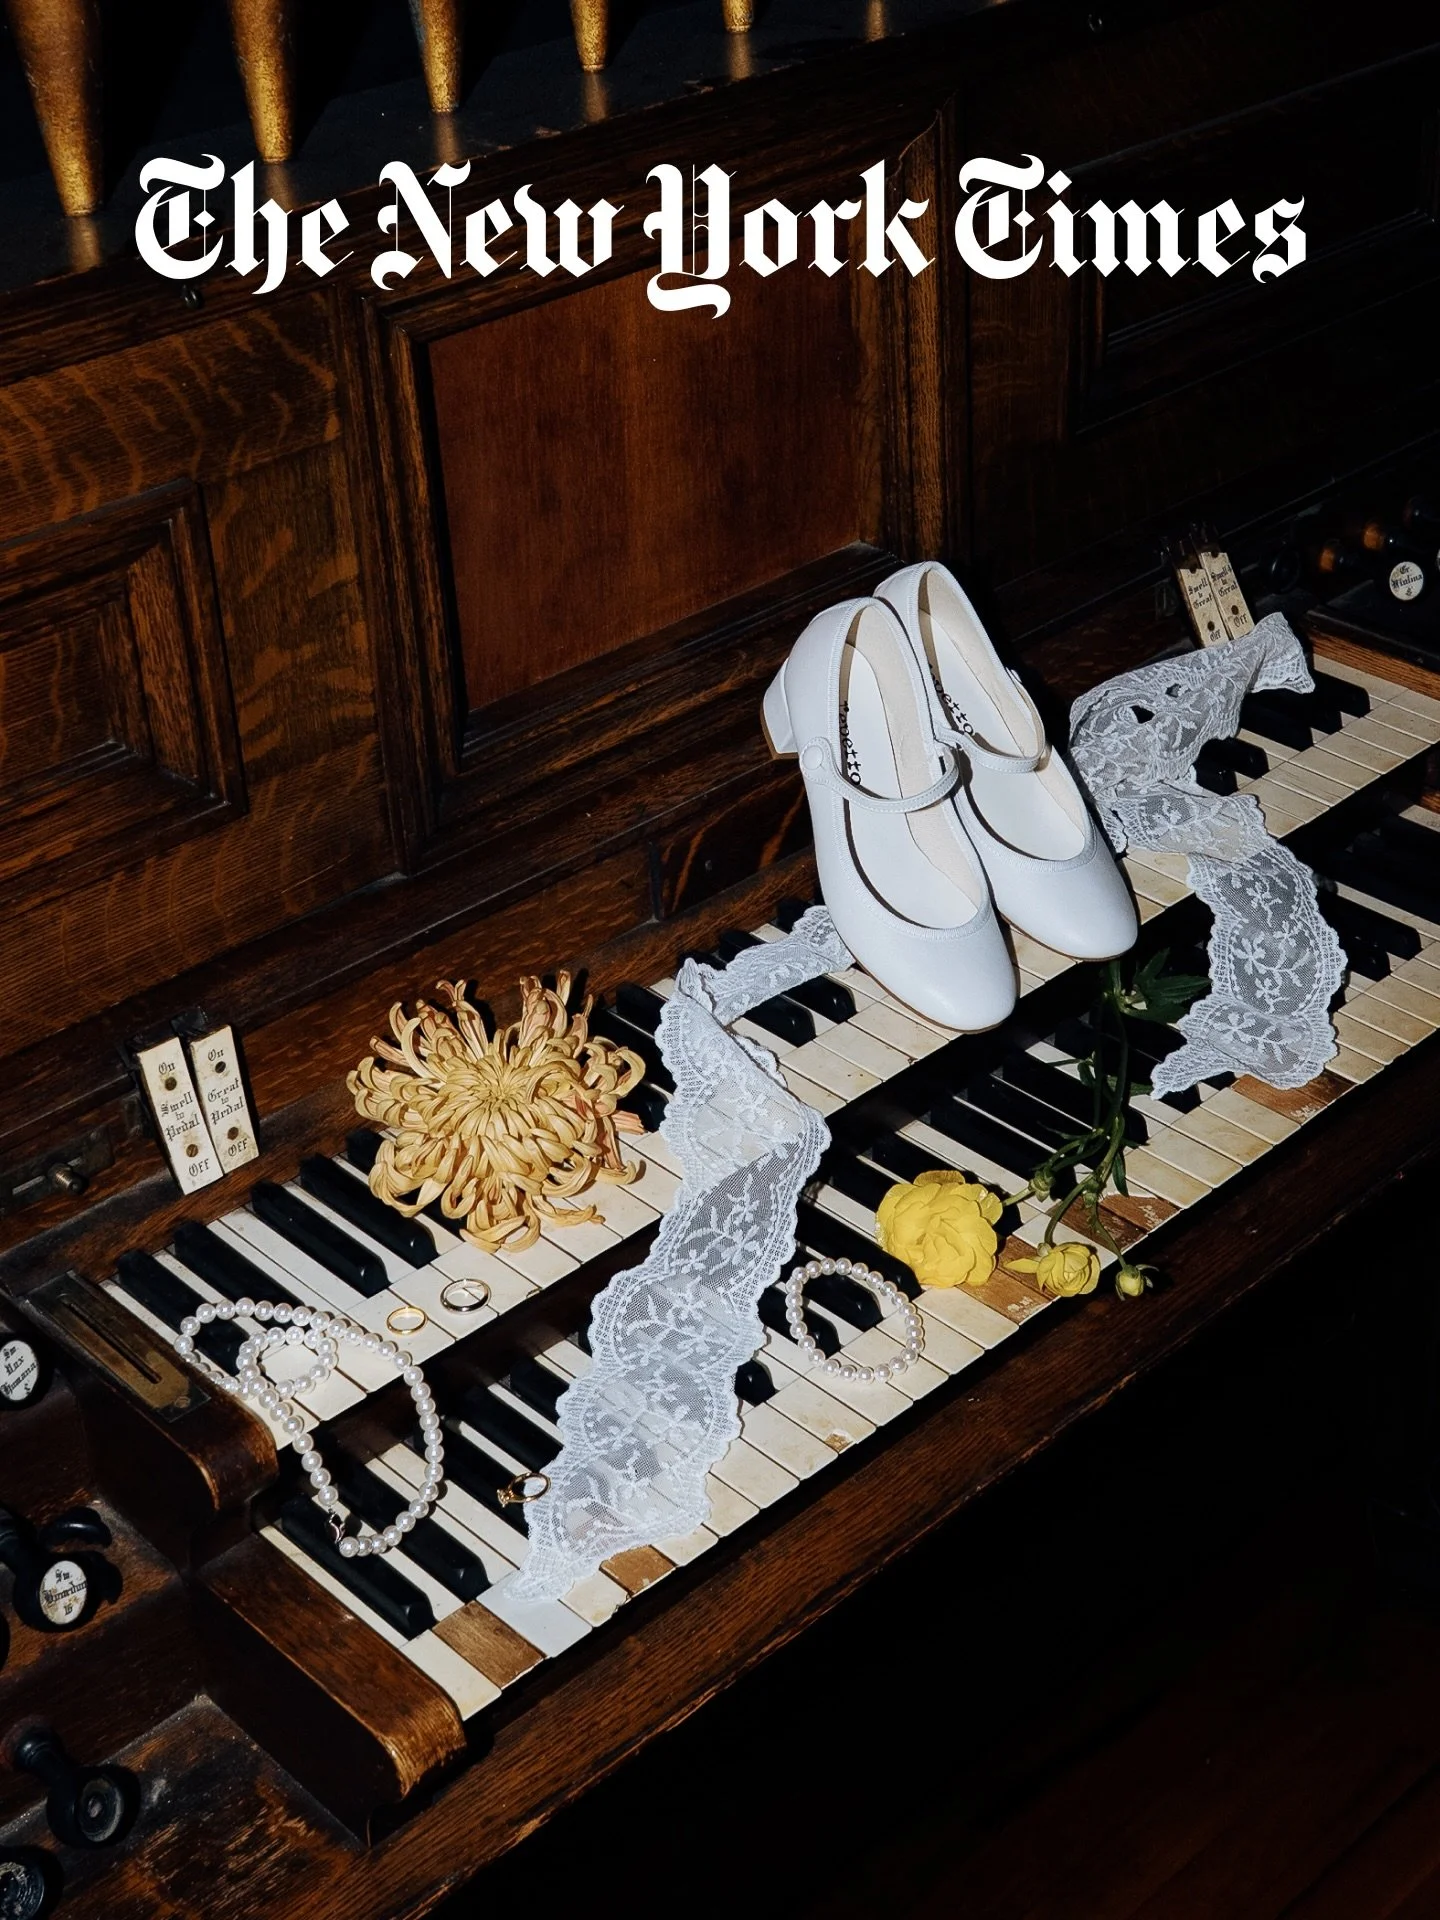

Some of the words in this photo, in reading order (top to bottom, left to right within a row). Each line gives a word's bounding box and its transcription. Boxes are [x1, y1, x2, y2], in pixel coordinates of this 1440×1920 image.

[208, 1048, 224, 1062] On
[158, 1062, 175, 1075] On
[207, 1077, 241, 1103] Great
[160, 1091, 194, 1117] Swell
[211, 1096, 244, 1125] Pedal
[165, 1113, 200, 1142] Pedal
[228, 1138, 248, 1157] Off
[188, 1158, 210, 1177] Off
